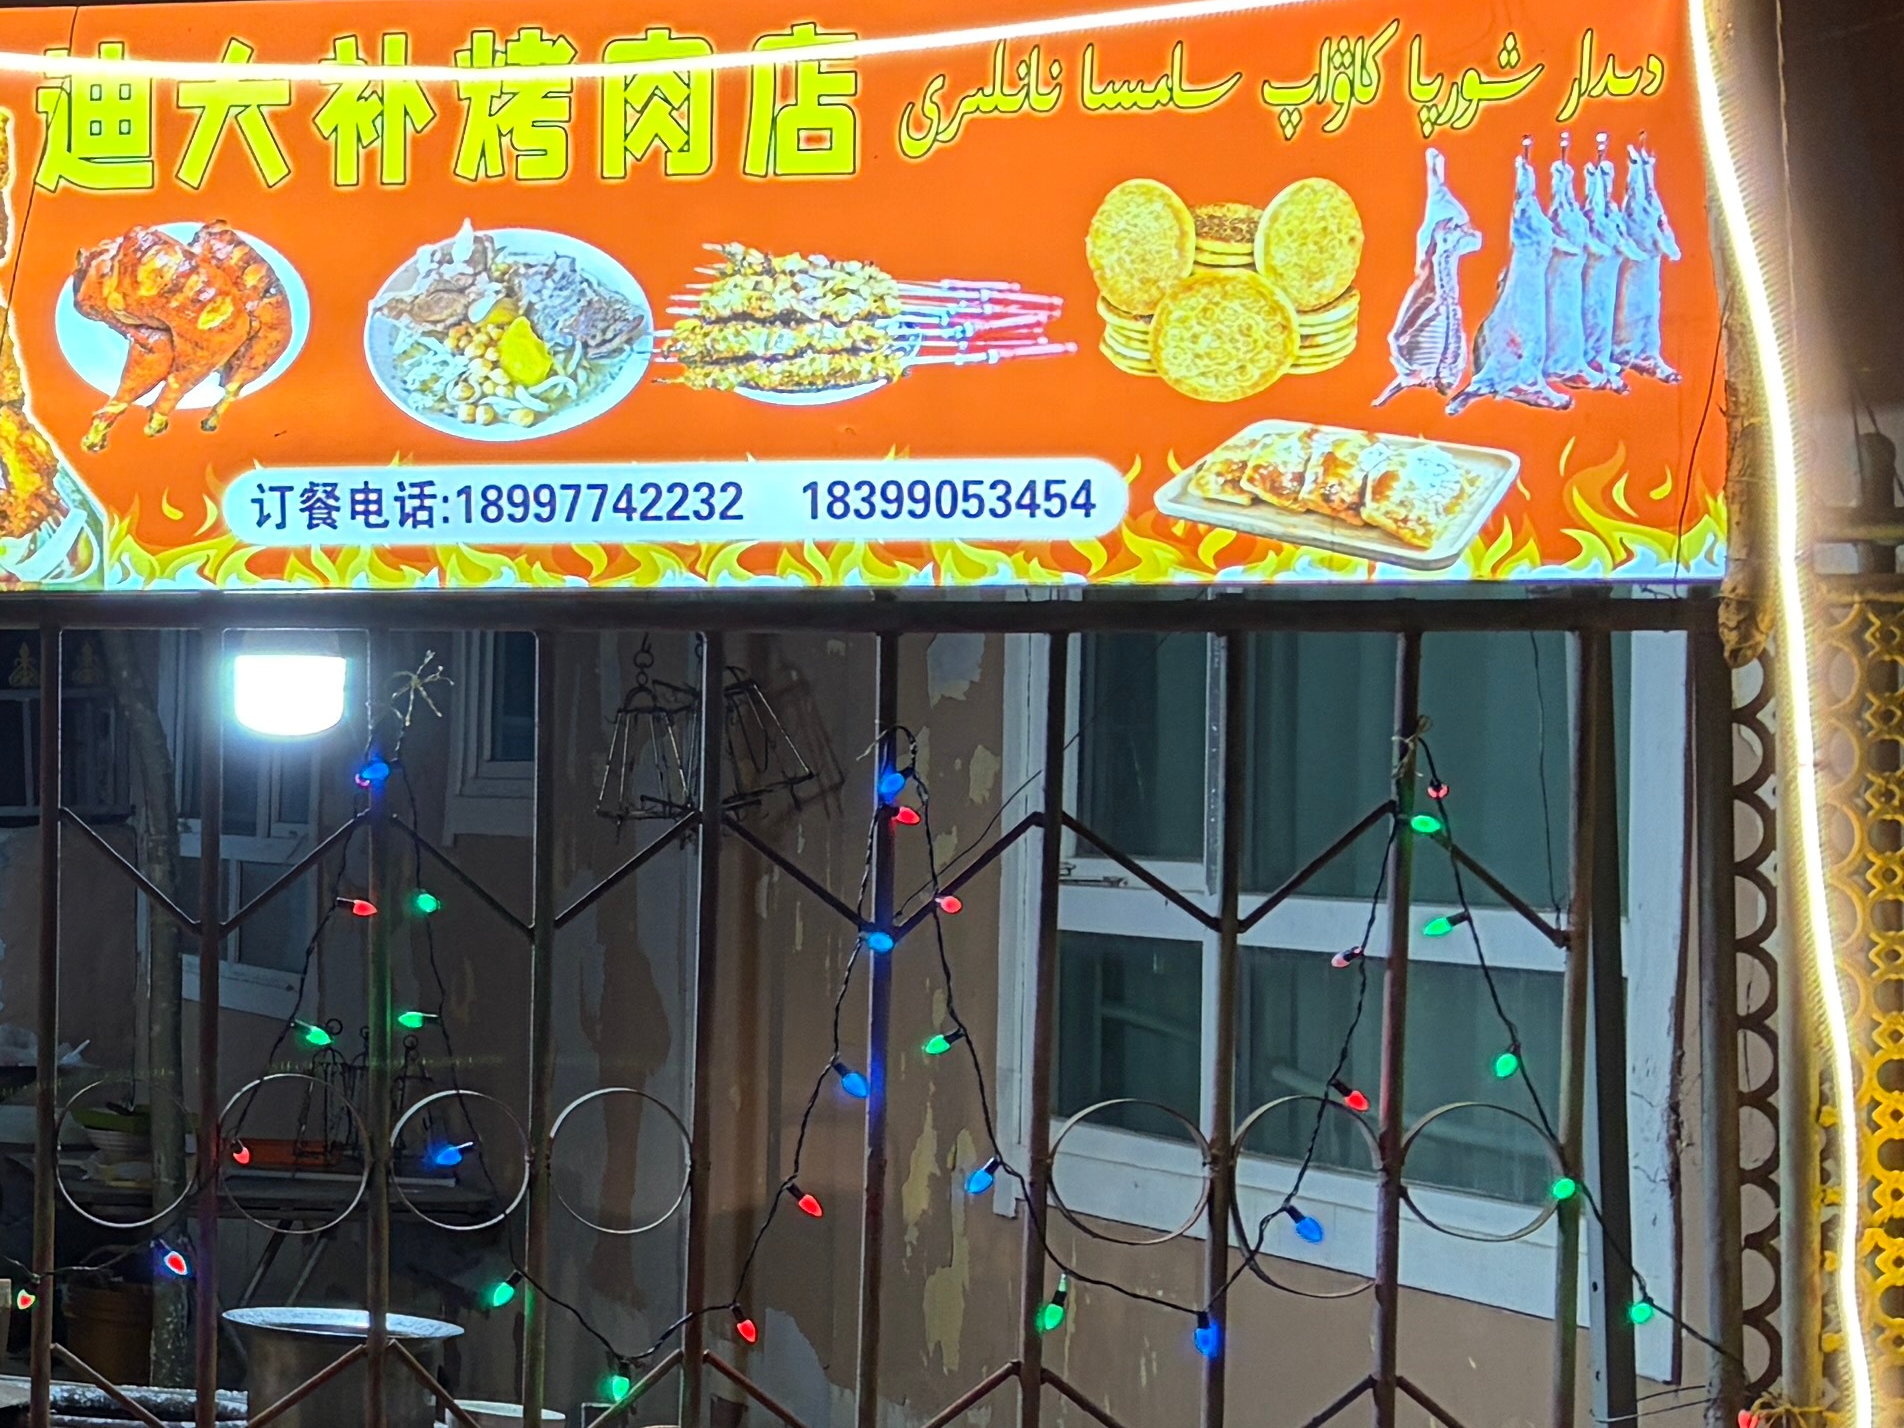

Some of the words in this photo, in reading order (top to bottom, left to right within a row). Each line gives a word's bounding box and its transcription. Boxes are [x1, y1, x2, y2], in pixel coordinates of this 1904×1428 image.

[34, 22, 860, 193] 迪大补烤肉店
[250, 479, 745, 532] 订餐电话:18997742232
[801, 479, 1099, 523] 18399053454
